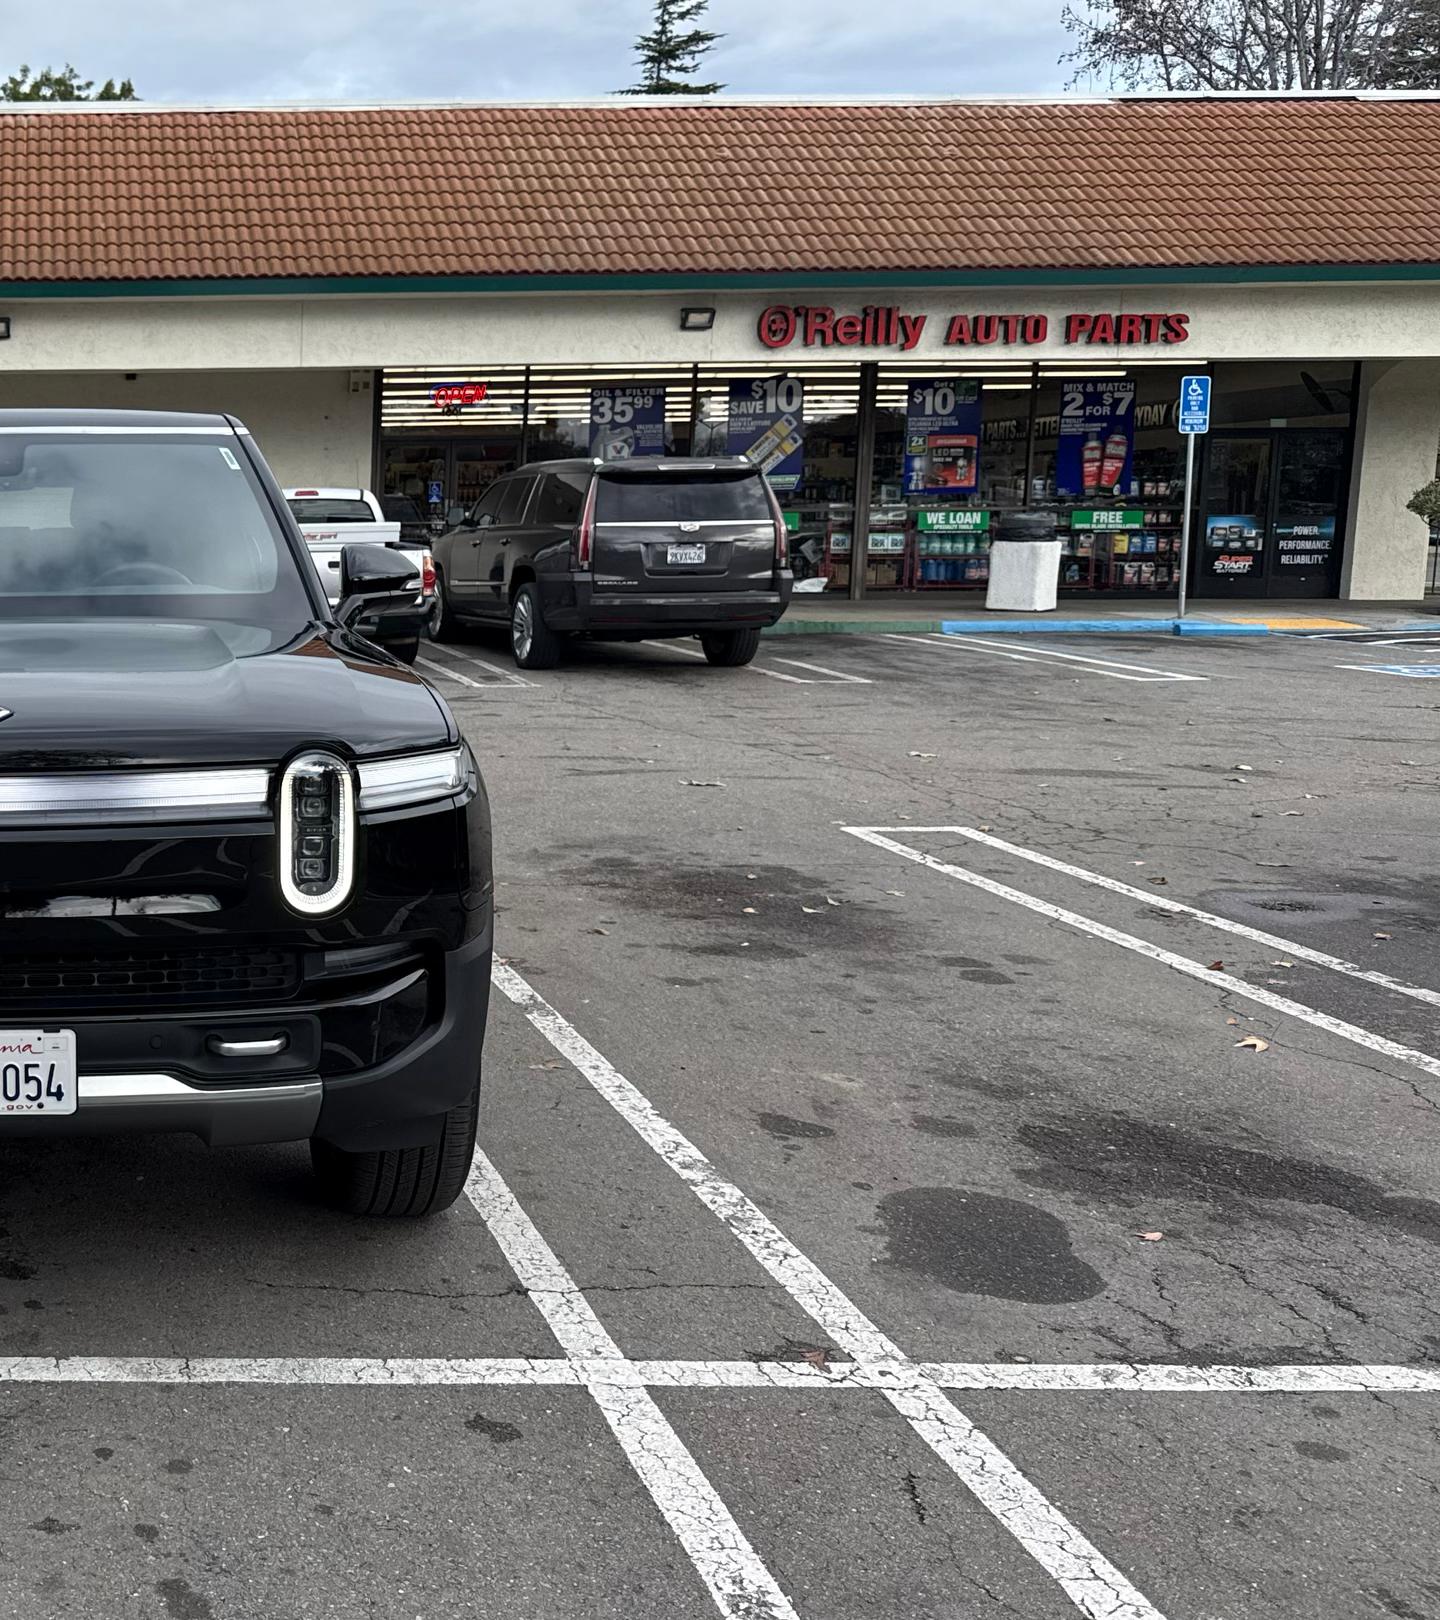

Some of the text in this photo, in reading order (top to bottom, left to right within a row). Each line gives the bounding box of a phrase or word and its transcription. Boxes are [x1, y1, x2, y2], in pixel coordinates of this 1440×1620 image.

[758, 304, 1190, 351] O'Reilly AUTO PARTS
[592, 387, 664, 397] OIL & FILTER
[1063, 382, 1134, 393] MIX & MATCH
[435, 384, 487, 408] OPEN
[730, 378, 803, 414] SAVE $10
[913, 388, 955, 416] $10
[1062, 391, 1134, 416] 2 FOR $7
[927, 512, 981, 524] WE LOAN
[1092, 511, 1123, 523] FREE
[1293, 525, 1320, 535] POWER.
[1279, 540, 1332, 550] PERFORMANCE.
[1213, 560, 1253, 569] START
[1218, 555, 1253, 563] SUPER
